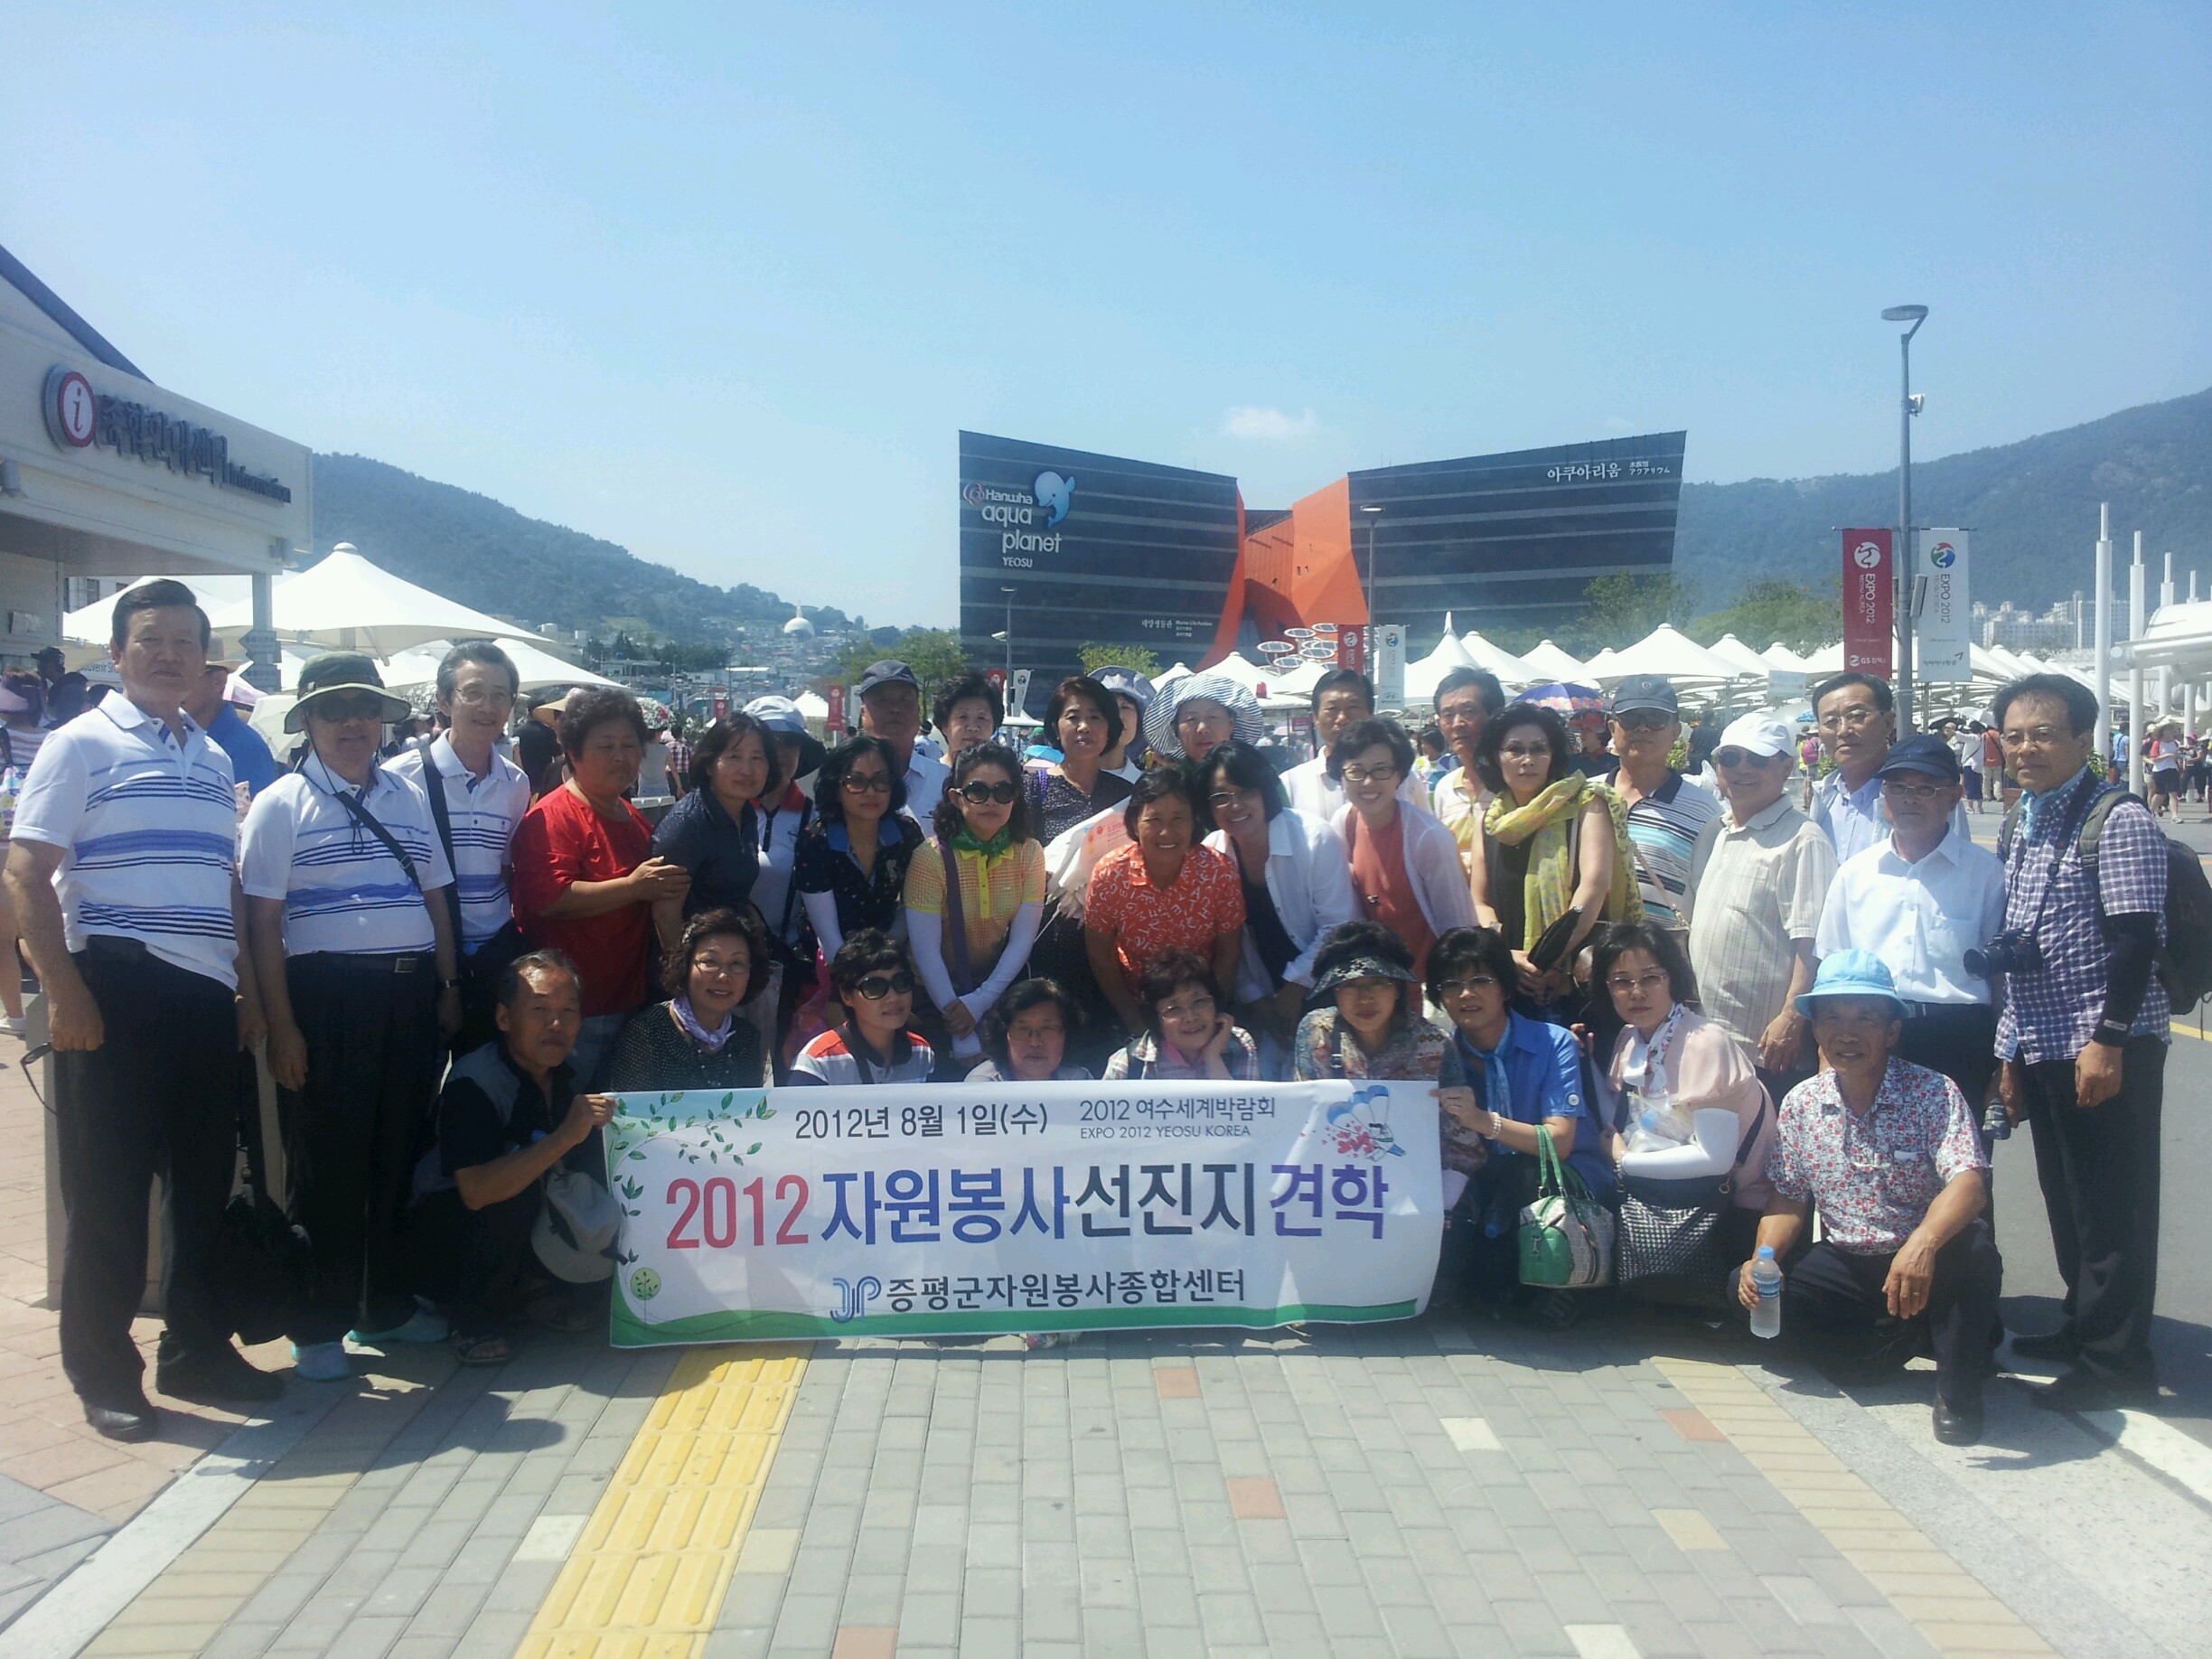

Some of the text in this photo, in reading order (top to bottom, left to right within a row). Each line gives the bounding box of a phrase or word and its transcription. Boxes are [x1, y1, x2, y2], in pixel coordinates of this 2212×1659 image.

[1547, 462, 1622, 483] 아쿠아리움
[1629, 466, 1671, 475] アクアリウム
[985, 489, 1034, 505] Hanwha
[981, 505, 1033, 528] aqua
[1002, 529, 1063, 554] planet
[1002, 557, 1033, 568] YEOSU
[1865, 573, 1876, 623] EXPO 2012
[1940, 574, 1950, 623] EXPO 2012
[795, 1102, 1048, 1139] 2012년 8월 1일(수)
[1080, 1096, 1276, 1122] 2012 여수세계박람회
[1081, 1125, 1251, 1139] EXPO 2012 YEOSU KOREA
[666, 1174, 810, 1250] 2012
[886, 1269, 1245, 1313] 증평군자원봉사종합센터
